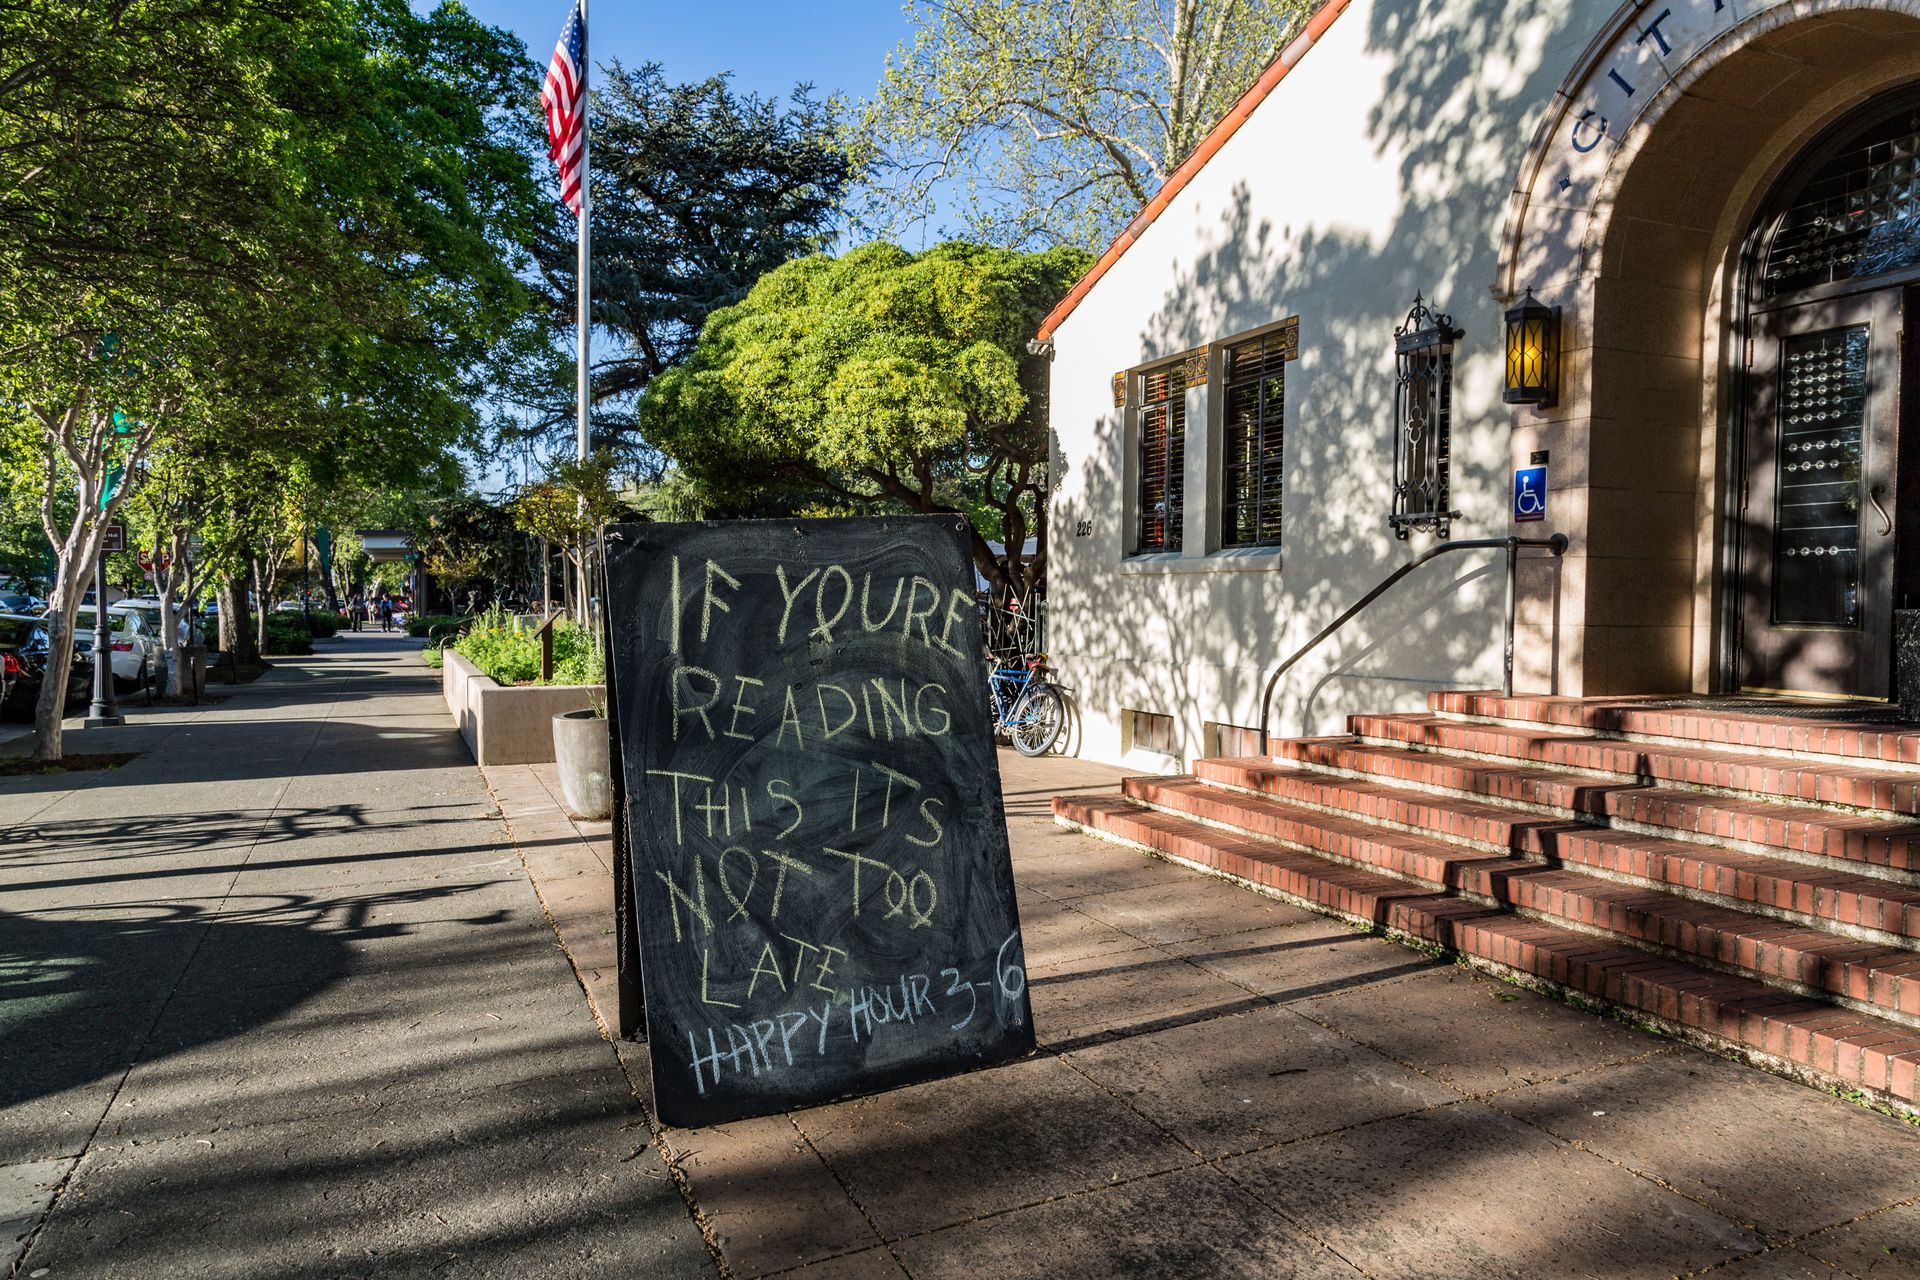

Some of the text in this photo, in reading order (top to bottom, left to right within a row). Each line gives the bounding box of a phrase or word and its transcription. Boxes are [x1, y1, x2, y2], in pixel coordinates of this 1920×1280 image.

[1571, 0, 1724, 153] CIT
[140, 553, 170, 564] SP
[1076, 520, 1093, 537] 226
[671, 555, 976, 659] IF YOURE
[672, 666, 951, 750] READING
[646, 760, 944, 848] THIS ITS
[656, 846, 937, 942] NOT TOO
[689, 930, 1025, 1094] HAPPY HOUR 3-6
[702, 932, 848, 1008] LATE
